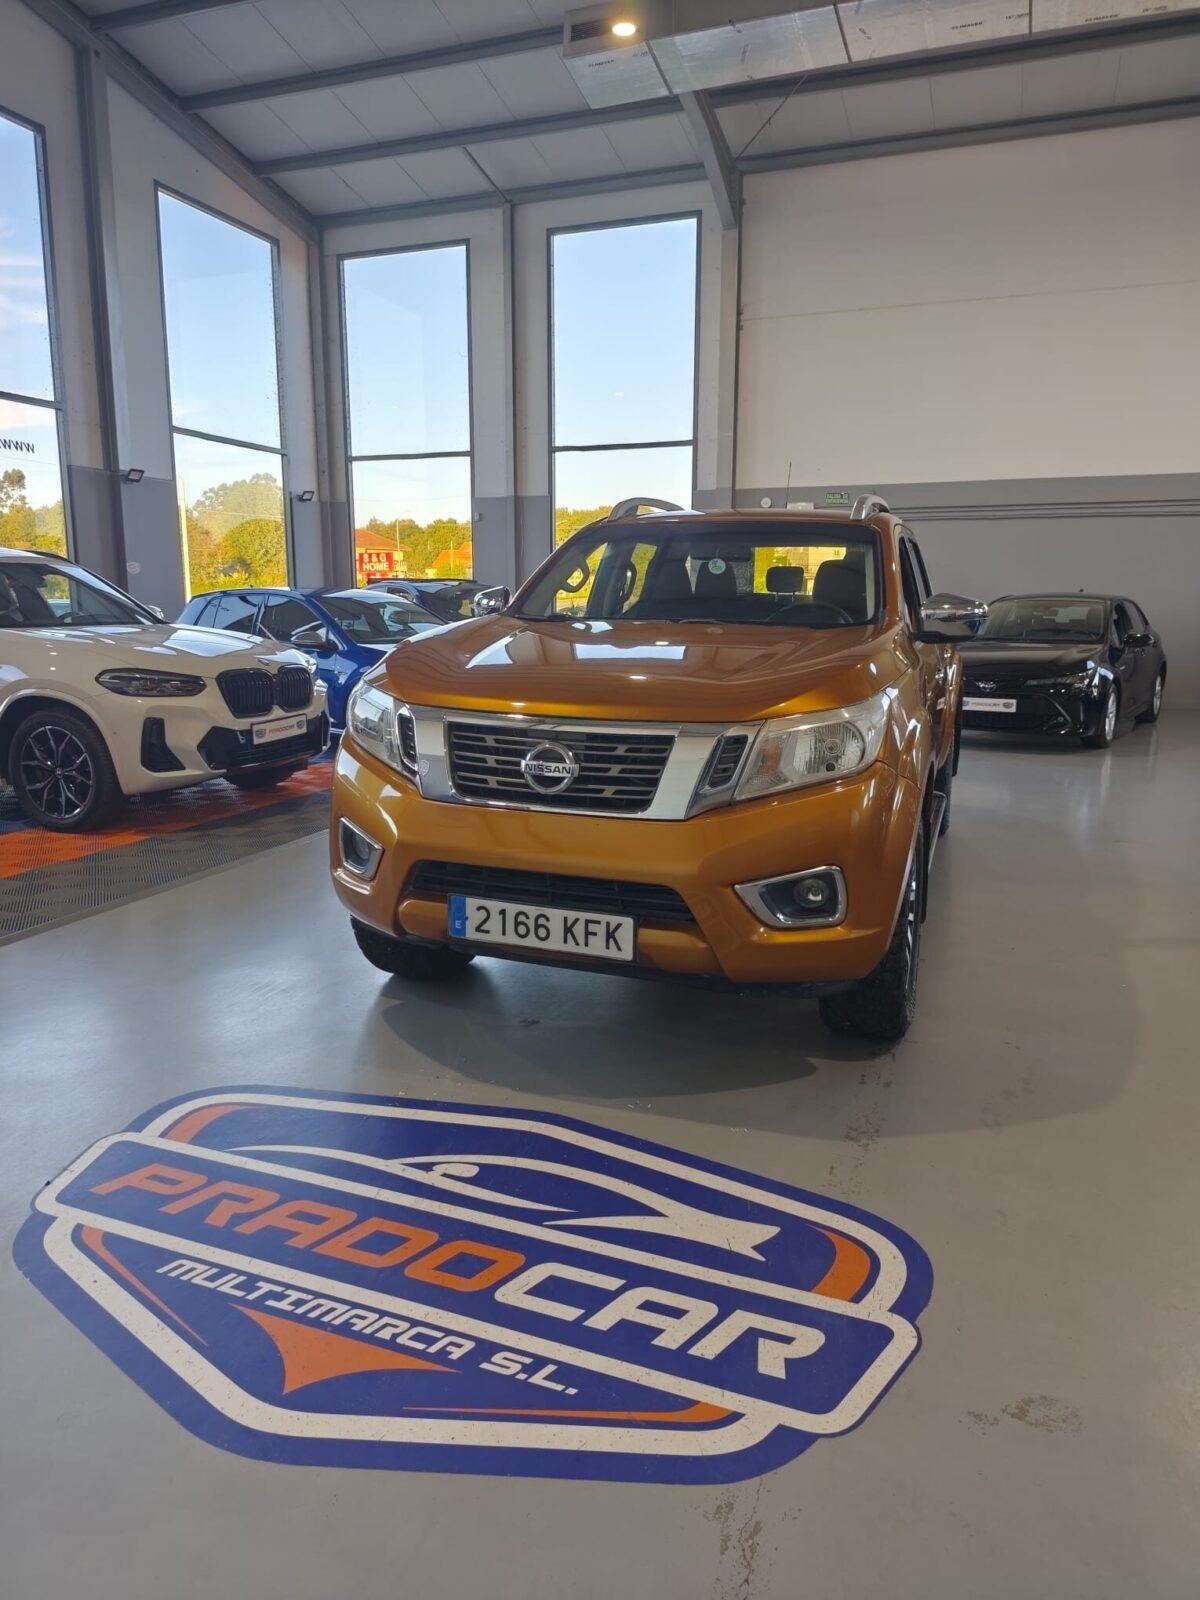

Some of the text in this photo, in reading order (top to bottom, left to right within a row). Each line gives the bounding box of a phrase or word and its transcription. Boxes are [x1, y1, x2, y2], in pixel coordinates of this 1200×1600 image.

[363, 553, 370, 562] S
[363, 562, 390, 571] HOME
[526, 763, 571, 775] NISSAN
[455, 920, 462, 928] E
[475, 906, 623, 951] 2166 KFK
[156, 1259, 579, 1395] MULTIMARCA S.L.
